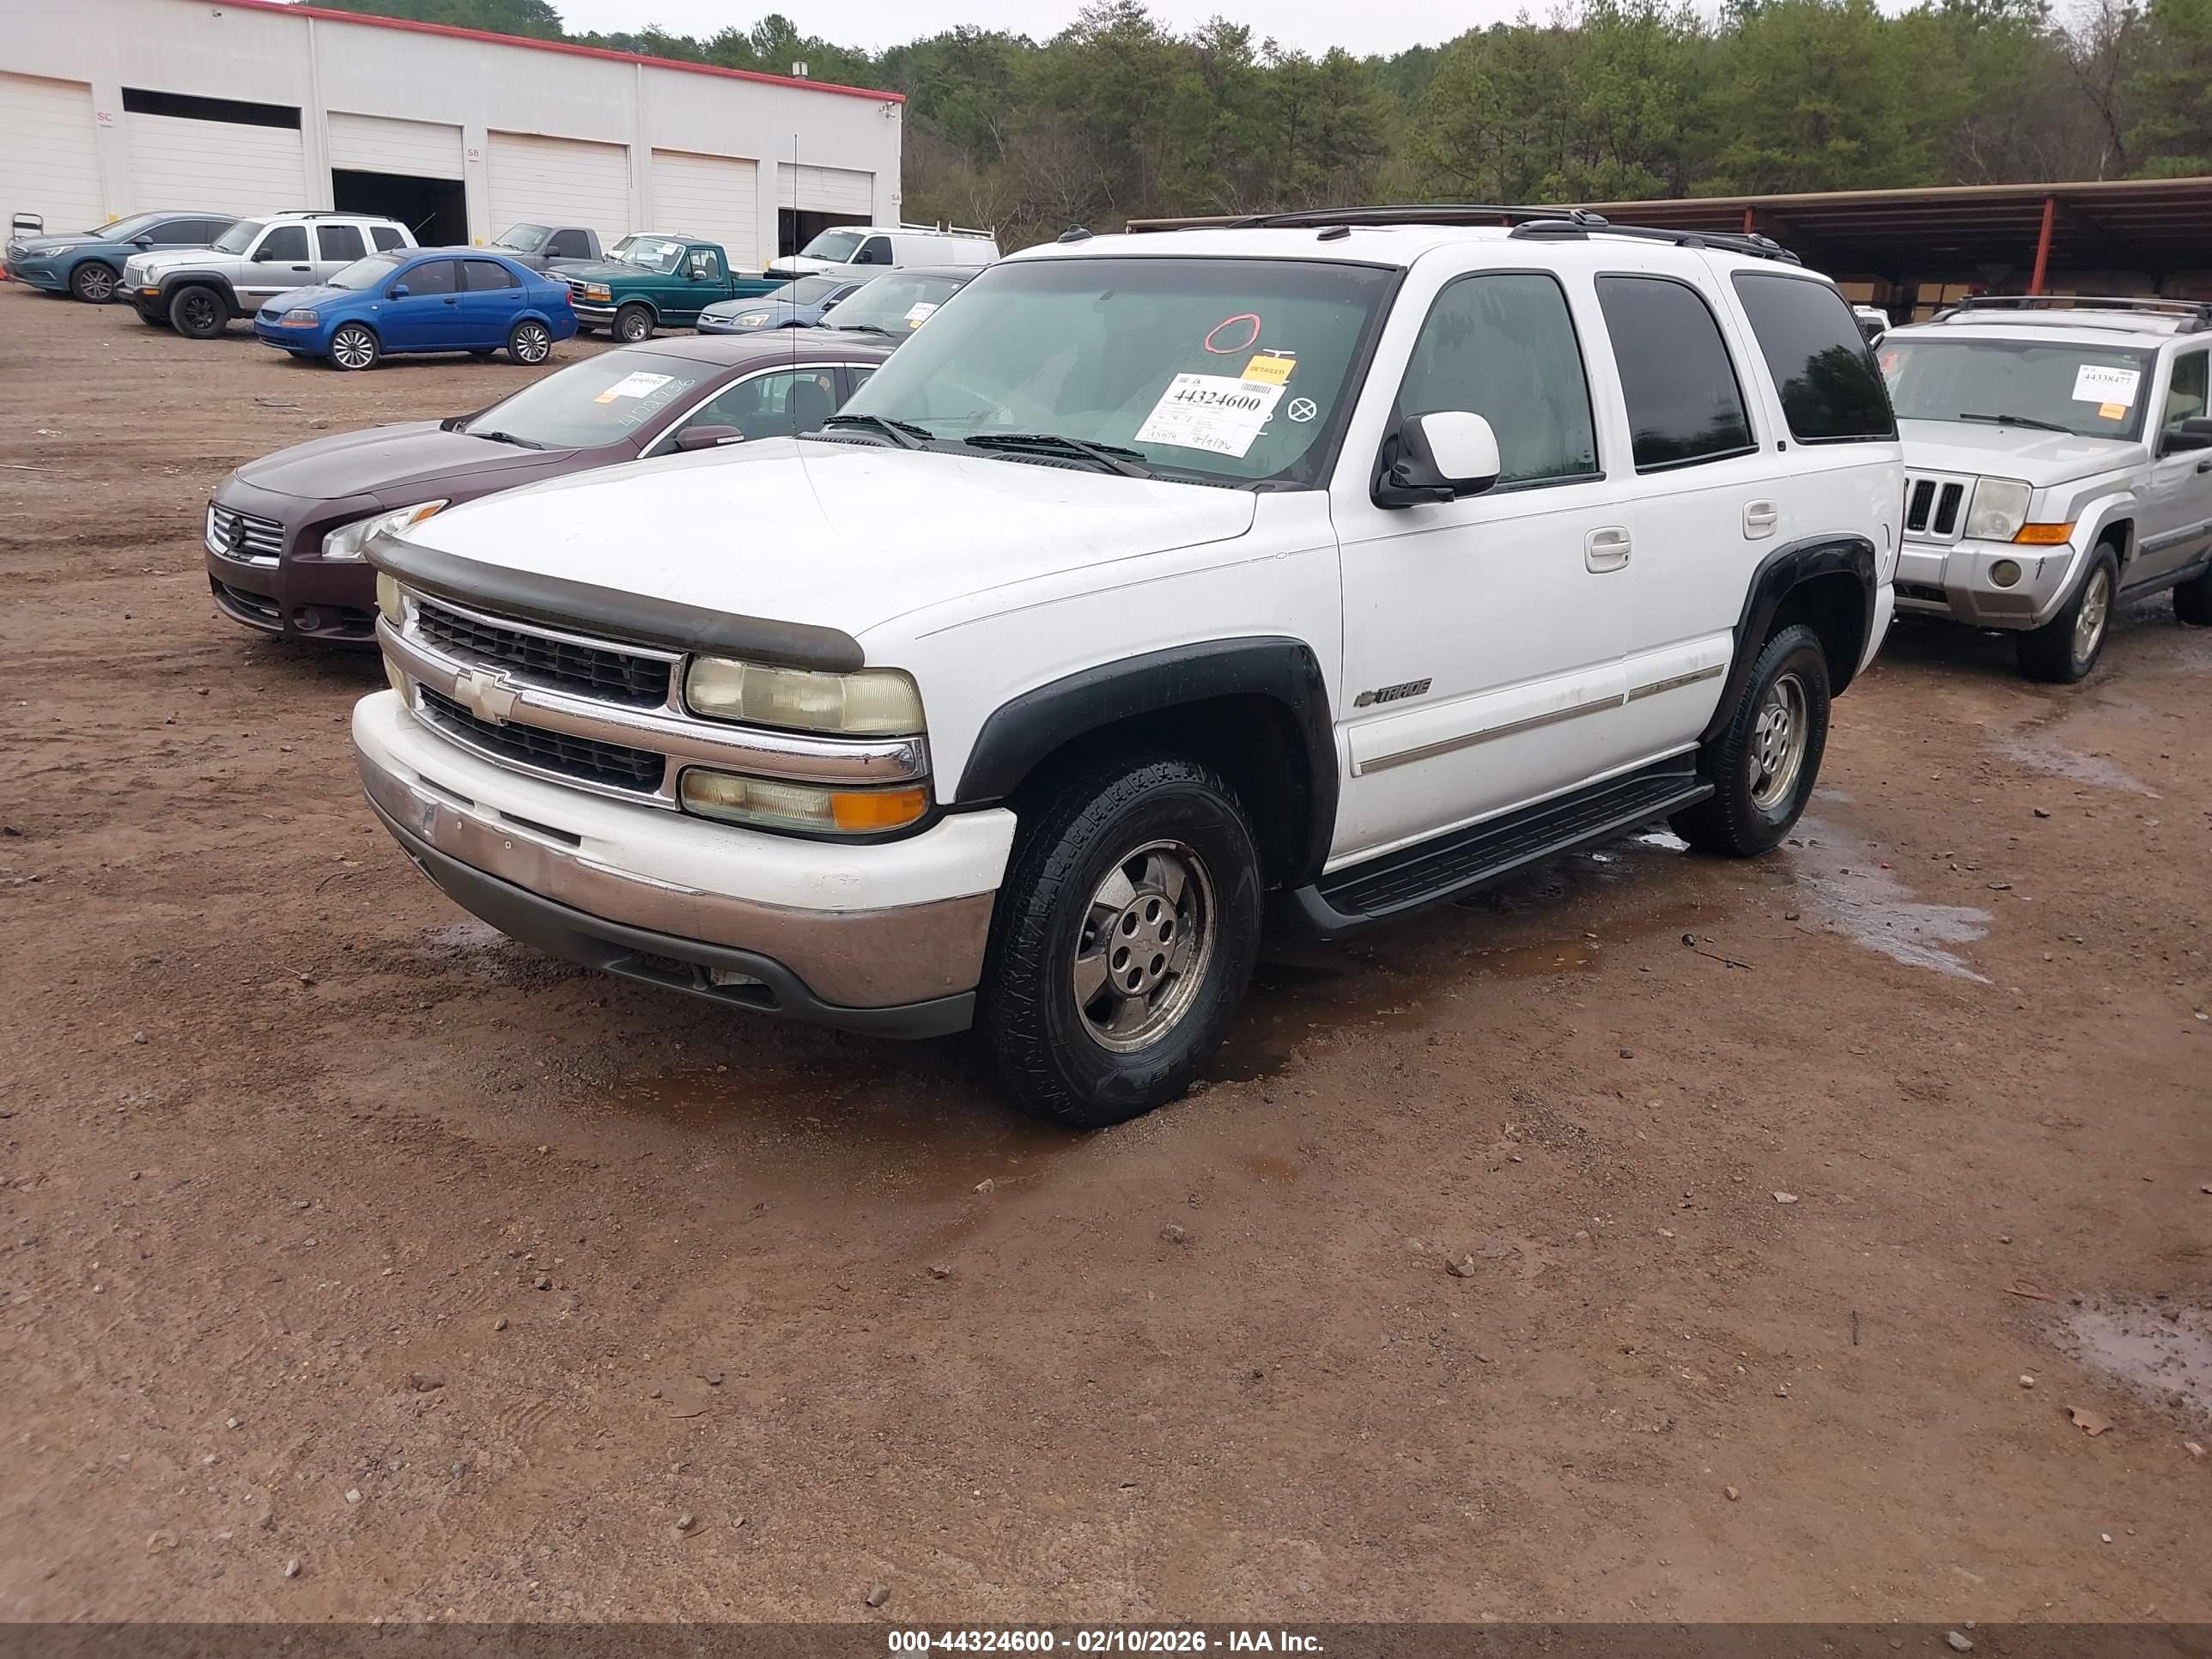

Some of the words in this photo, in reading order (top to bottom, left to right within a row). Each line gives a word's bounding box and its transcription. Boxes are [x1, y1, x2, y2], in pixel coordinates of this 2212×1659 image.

[97, 112, 112, 122] SC
[467, 149, 479, 157] SB
[1249, 366, 1285, 375] DETAILED
[2084, 373, 2131, 385] 44338477
[1174, 389, 1261, 411] 44324600
[1378, 678, 1431, 703] TAHOE
